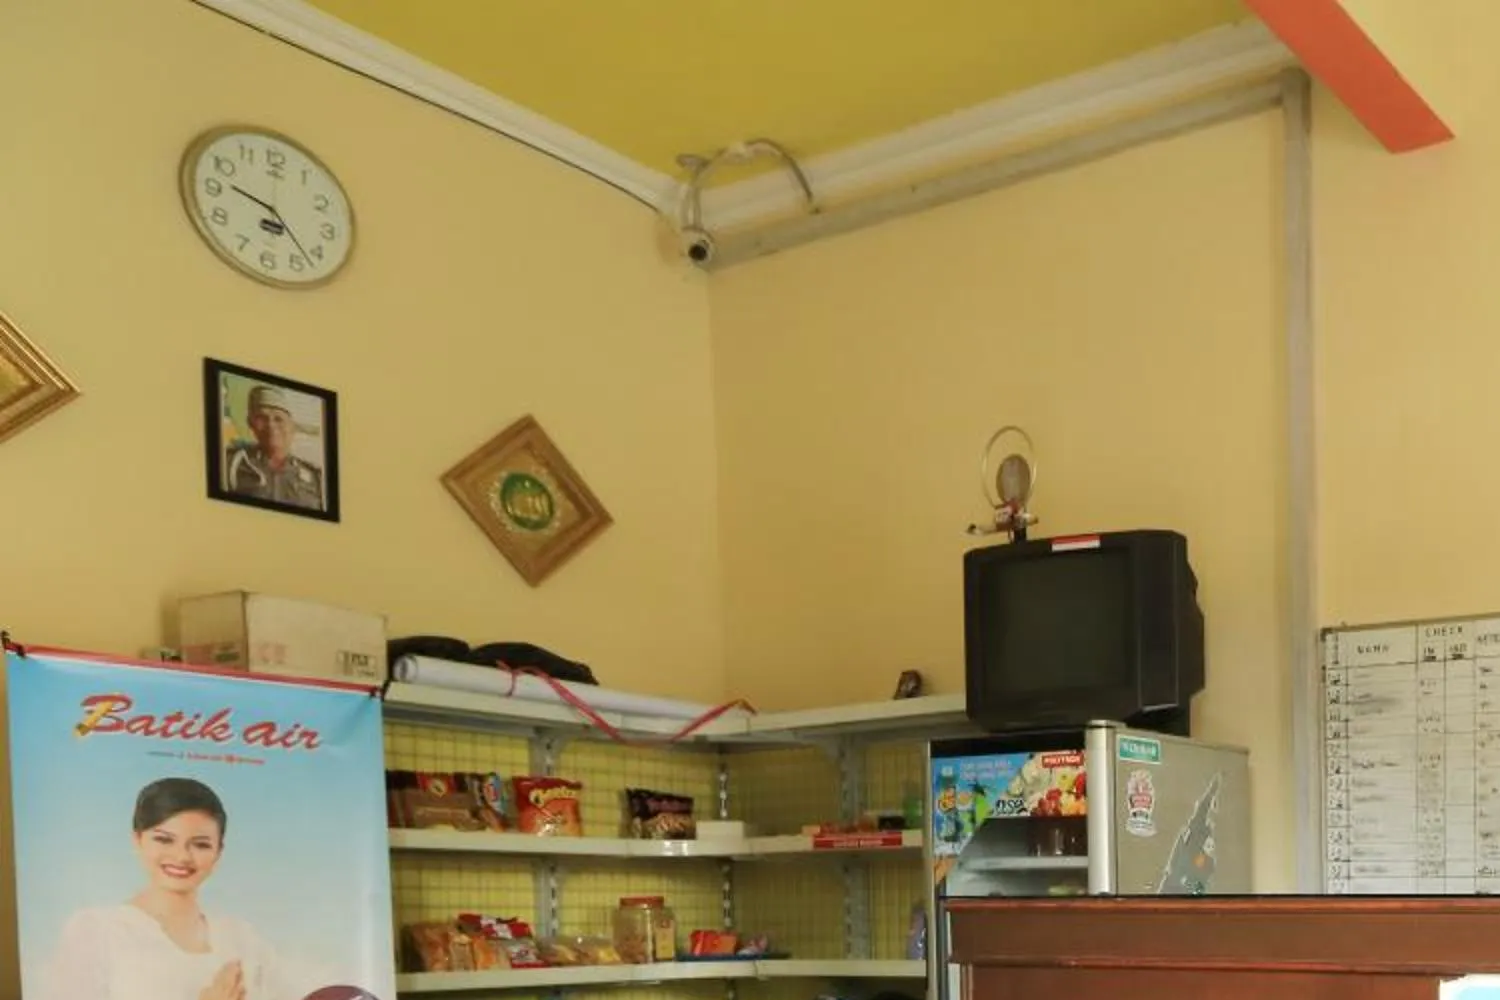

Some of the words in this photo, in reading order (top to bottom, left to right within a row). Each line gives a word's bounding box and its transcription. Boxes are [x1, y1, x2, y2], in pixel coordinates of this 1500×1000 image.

[239, 144, 254, 165] 11
[213, 155, 236, 177] 10
[205, 177, 222, 197] 9
[314, 194, 329, 213] 2
[211, 207, 228, 226] 8
[320, 223, 335, 240] 3
[235, 233, 250, 252] 7
[260, 252, 277, 270] 6
[310, 245, 324, 260] 4
[289, 253, 304, 272] 5
[73, 692, 234, 741] Batik
[242, 720, 321, 750] air
